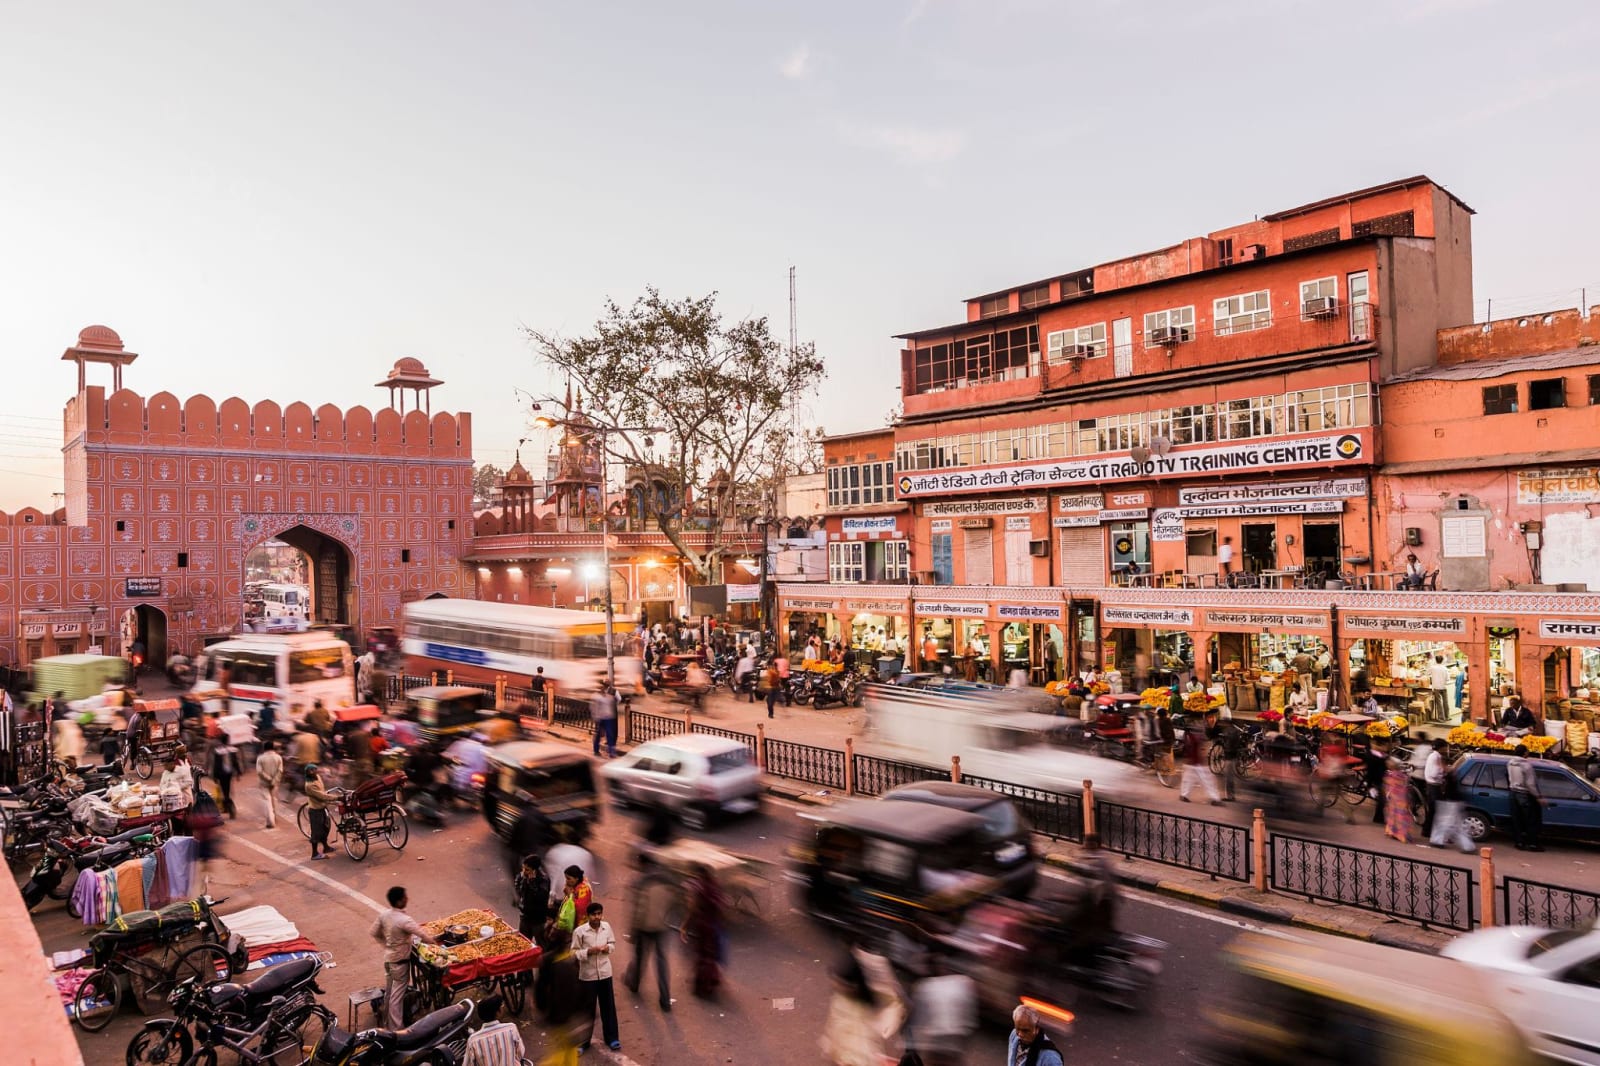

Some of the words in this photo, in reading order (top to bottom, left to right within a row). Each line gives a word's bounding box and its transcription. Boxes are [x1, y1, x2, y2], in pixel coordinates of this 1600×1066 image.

[1089, 464, 1110, 479] GT
[1111, 459, 1154, 477] RADIO
[1157, 457, 1176, 473] TV
[1180, 451, 1259, 471] TRAINING
[1262, 443, 1331, 465] CENTRE
[941, 473, 977, 488] रेडियो
[979, 470, 1008, 486] टीवी
[1048, 466, 1087, 480] सेन्टर
[1232, 485, 1311, 499] भोजनालय
[1231, 504, 1307, 515] भोजनालय
[1286, 615, 1304, 624] राय
[1348, 617, 1378, 628] गोपाल
[1380, 618, 1407, 630] कृष्ण
[1422, 618, 1461, 630] कम्पनी
[1544, 623, 1600, 635] रामच
